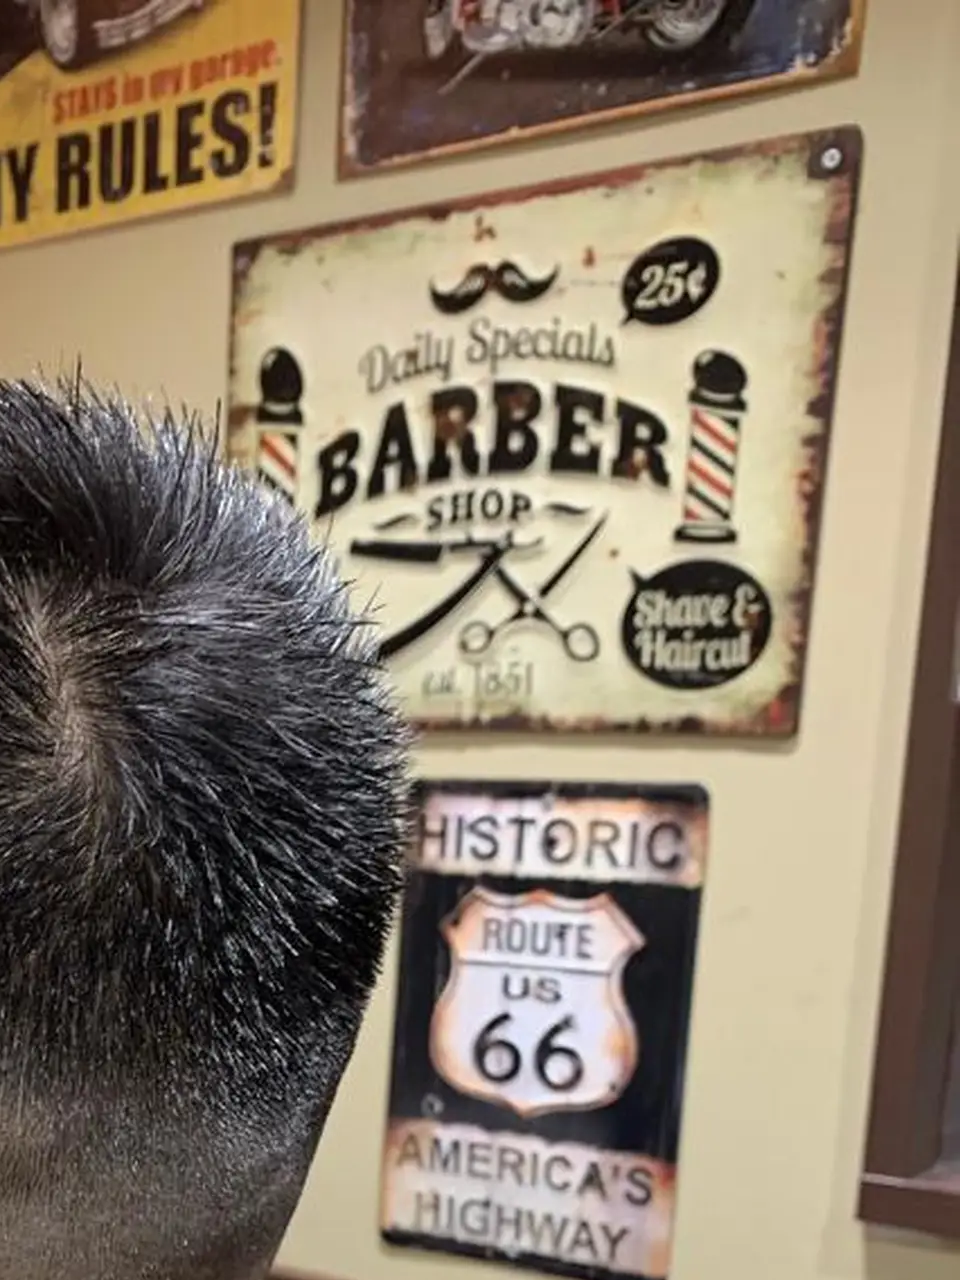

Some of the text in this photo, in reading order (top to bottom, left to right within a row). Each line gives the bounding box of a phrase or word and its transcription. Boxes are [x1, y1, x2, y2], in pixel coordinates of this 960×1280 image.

[56, 81, 278, 215] RULES!
[634, 260, 707, 310] 25¢
[358, 316, 616, 394] Daily Specials
[315, 377, 671, 517] BARBER
[427, 489, 533, 530] SHOP
[633, 582, 762, 630] Shave &
[633, 627, 751, 672] Haircut
[418, 804, 684, 872] HISTORIC
[481, 916, 595, 961] ROUTE
[499, 973, 564, 1001] US
[472, 1012, 585, 1093] 66
[397, 1131, 656, 1207] AMERICA'S
[413, 1190, 630, 1263] HIGHWAY
